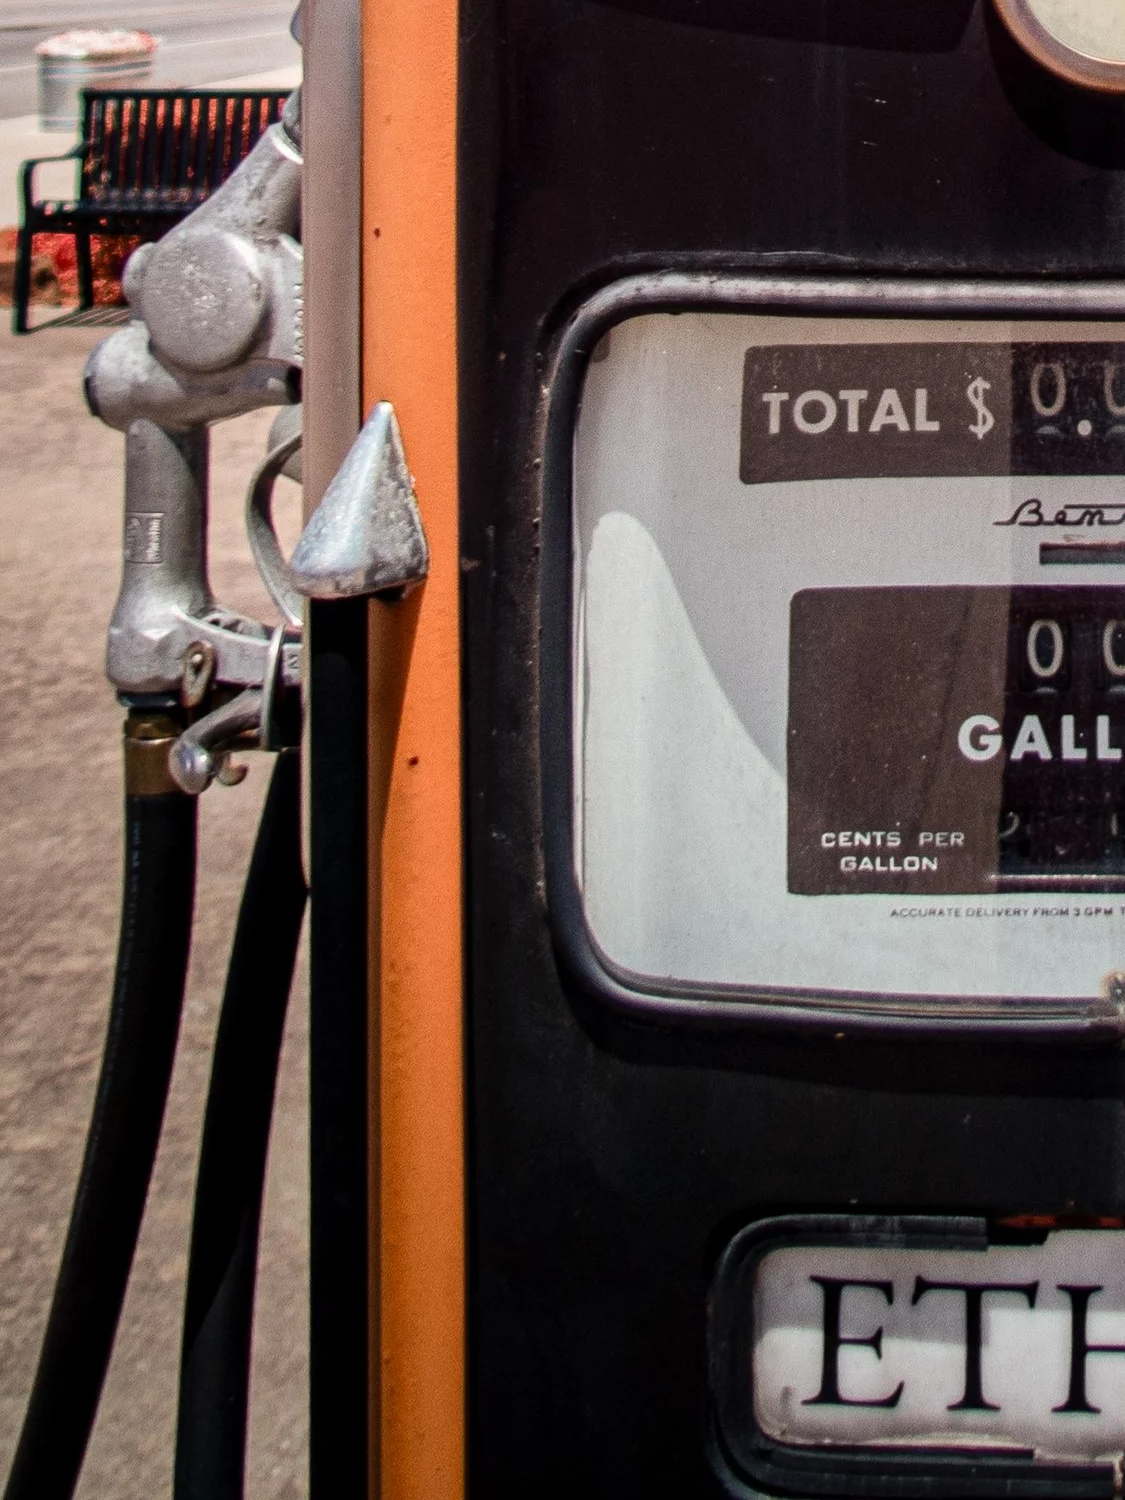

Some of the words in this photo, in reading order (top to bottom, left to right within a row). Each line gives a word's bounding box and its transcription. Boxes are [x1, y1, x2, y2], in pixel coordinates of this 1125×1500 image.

[761, 384, 941, 436] TOTAL
[966, 377, 996, 440] $
[821, 831, 902, 848] CENTS
[918, 831, 966, 848] PER
[839, 855, 939, 873] GALLON
[889, 907, 960, 918] ACCURATE
[965, 907, 1030, 917] DELIVERY
[1032, 907, 1070, 917] FROM
